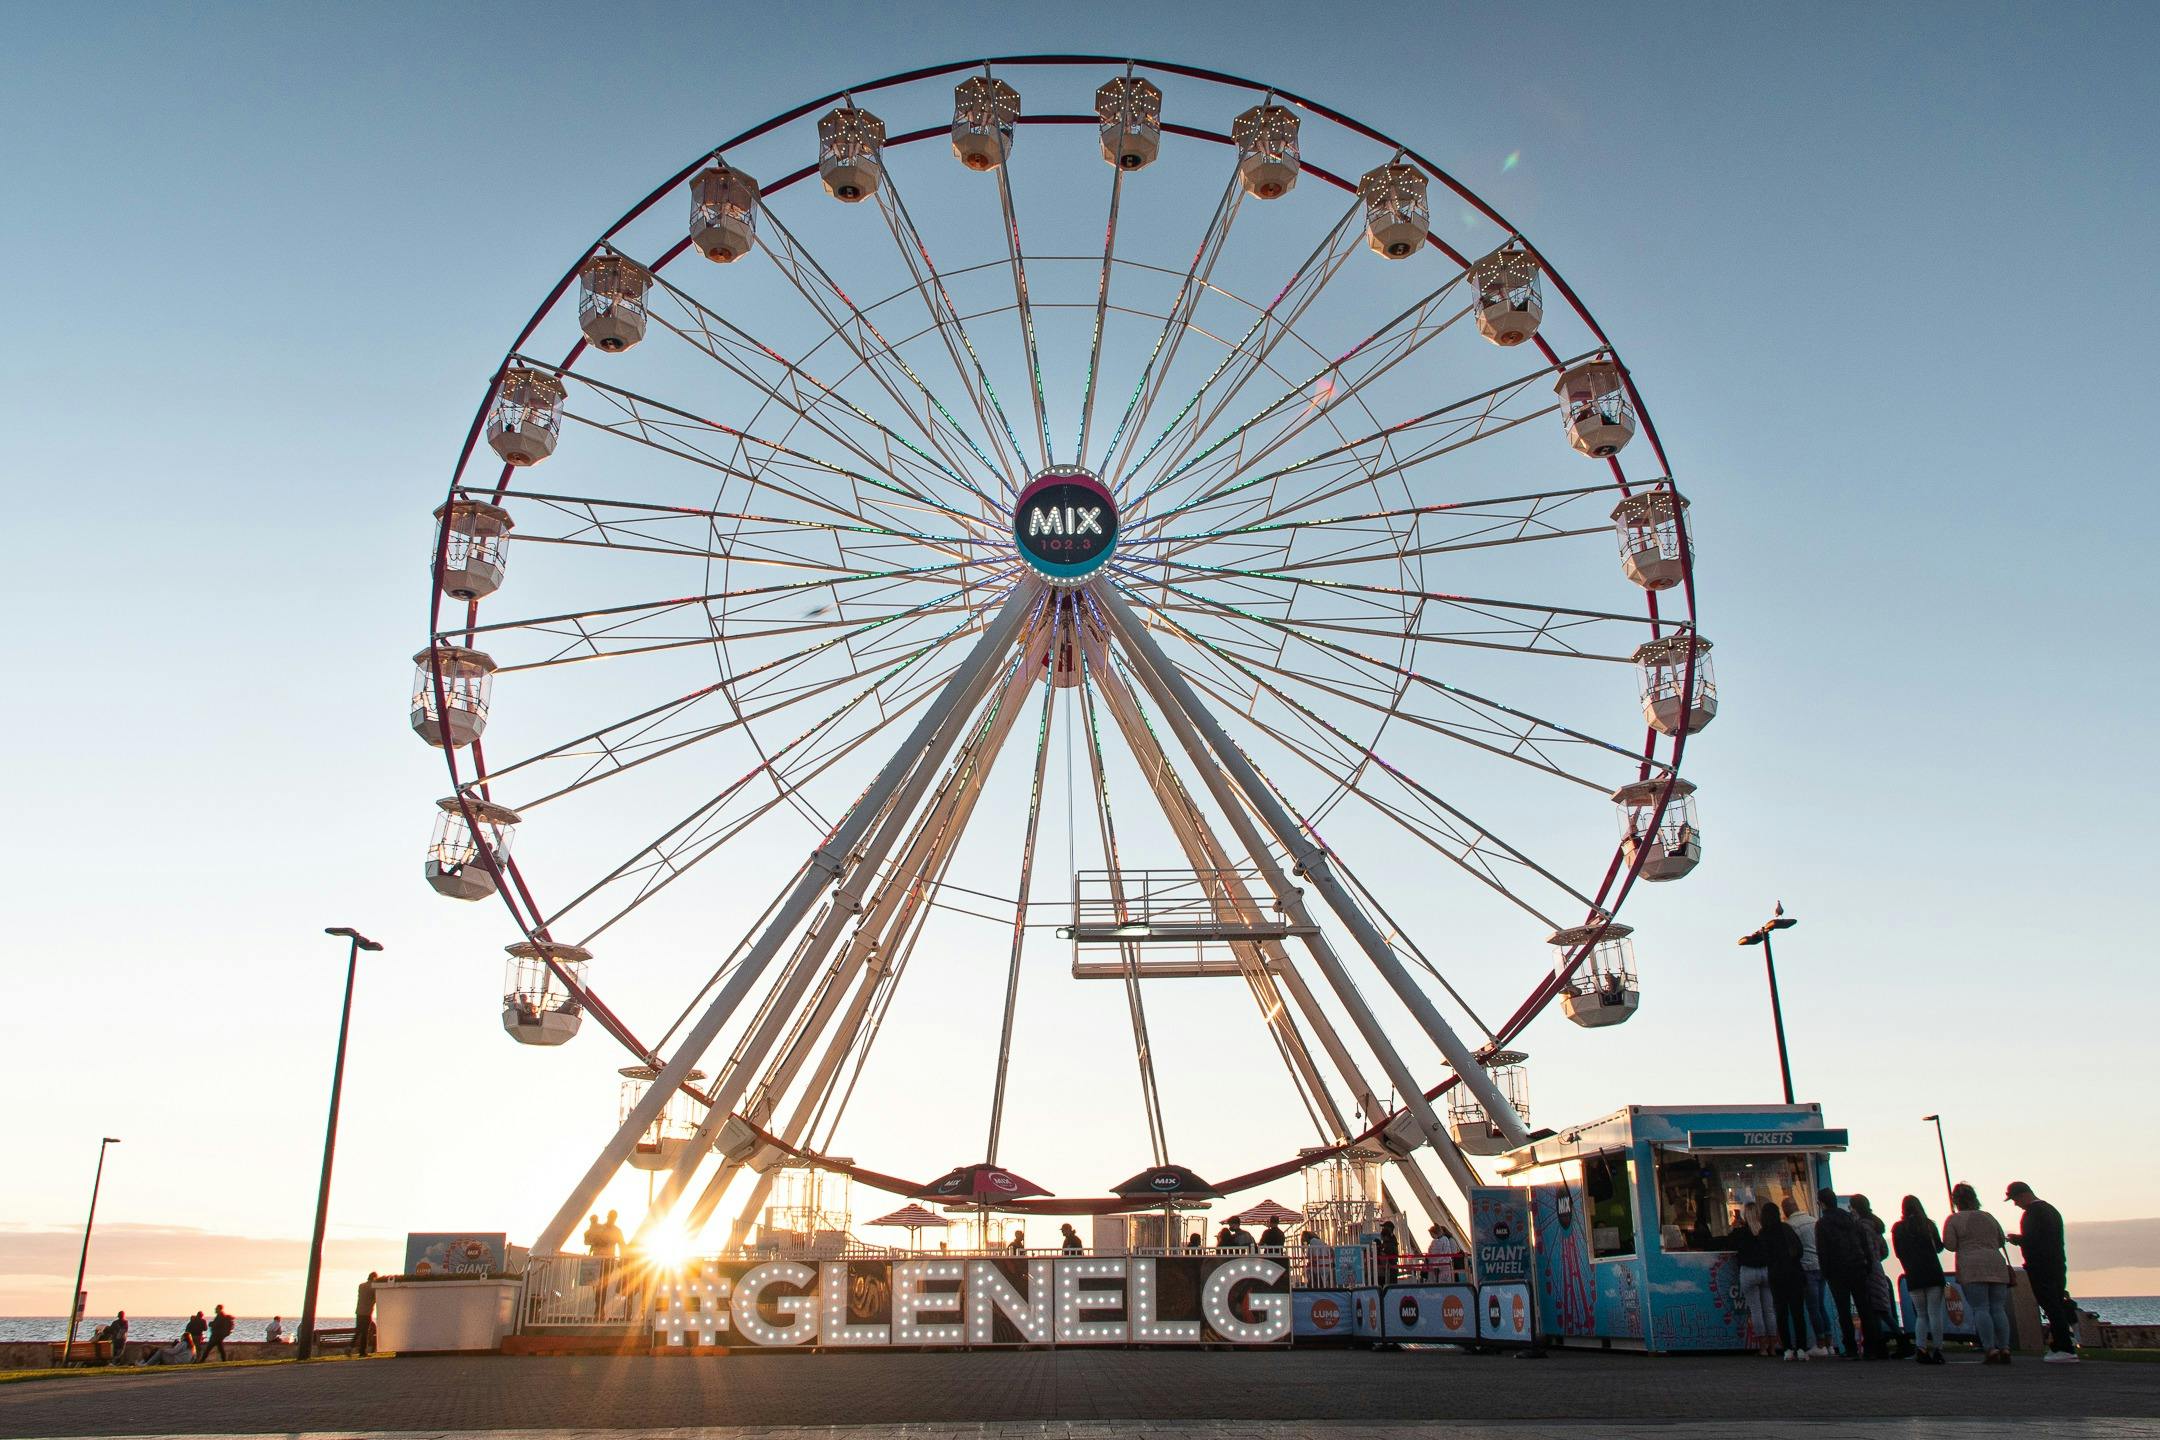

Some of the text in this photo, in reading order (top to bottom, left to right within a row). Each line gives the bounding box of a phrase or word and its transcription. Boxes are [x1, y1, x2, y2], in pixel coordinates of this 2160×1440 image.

[1029, 506, 1102, 536] MIX
[1041, 539, 1091, 550] 102.3
[1743, 1132, 1793, 1144] TICKETS
[1558, 1196, 1571, 1214] MIX
[1481, 1245, 1525, 1261] GIANT
[456, 1264, 491, 1274] GIANT
[1485, 1261, 1525, 1274] WHEEL
[655, 1258, 1292, 1346] #GLENELG
[1402, 1307, 1417, 1317] MIX
[1444, 1308, 1464, 1317] LUMO
